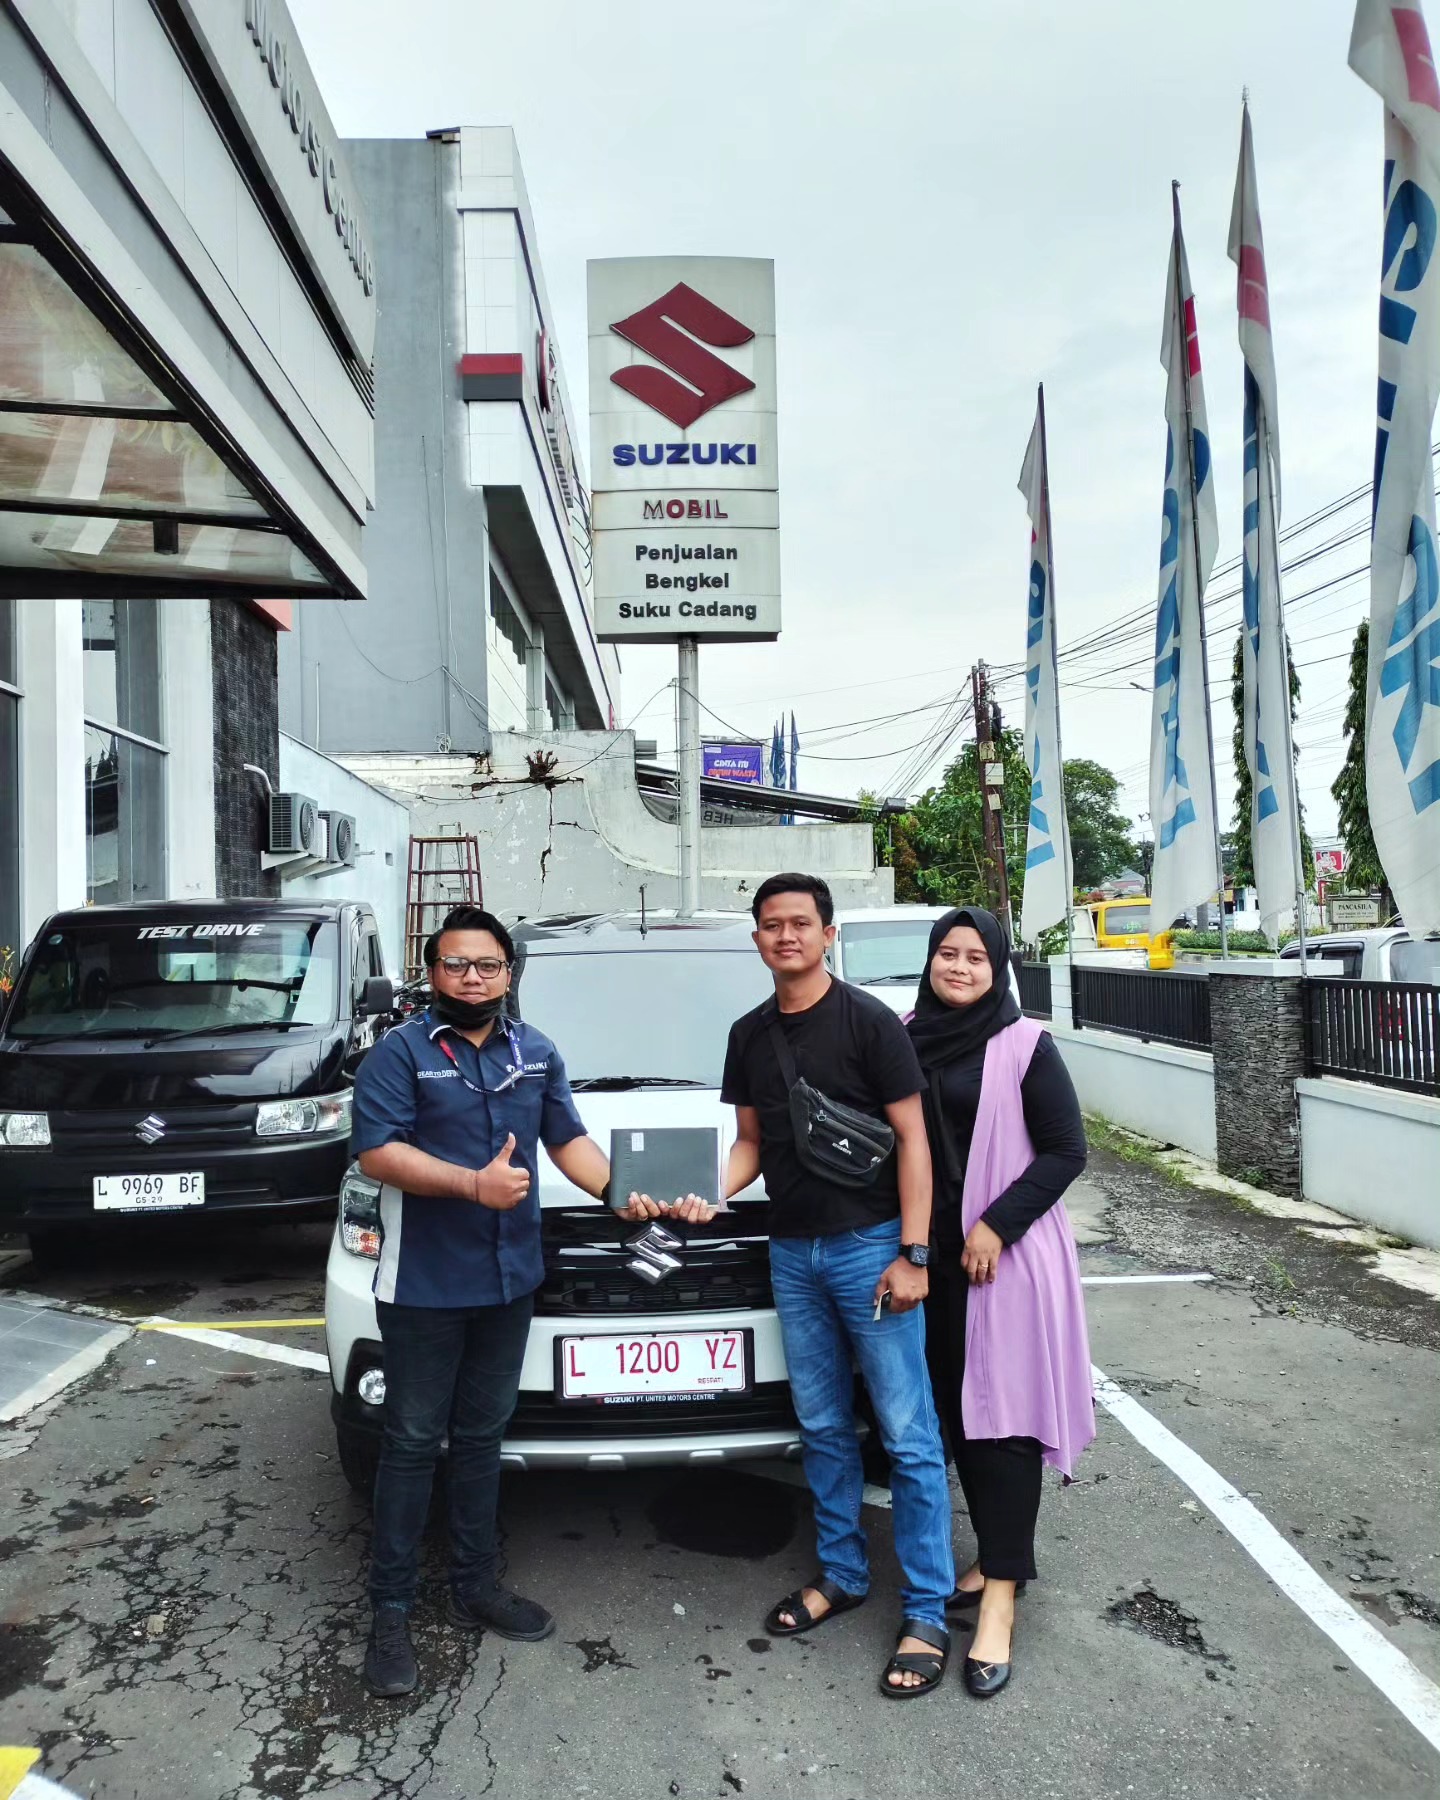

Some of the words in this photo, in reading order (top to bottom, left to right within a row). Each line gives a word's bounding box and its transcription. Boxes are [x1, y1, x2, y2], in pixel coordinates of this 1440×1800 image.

[613, 442, 757, 466] SUZUKI
[643, 499, 728, 519] MOBIL
[635, 544, 738, 562] Penjualan
[645, 573, 730, 591] Bengkel
[619, 602, 671, 619] Suku
[678, 601, 757, 621] Cadang
[714, 760, 736, 768] CINTA
[137, 925, 193, 939] TEST
[192, 924, 265, 938] DRIVE
[523, 1062, 548, 1070] ZUKI
[98, 1179, 107, 1196] L
[122, 1177, 163, 1195] 9969
[179, 1176, 199, 1193] BF
[570, 1346, 585, 1377] L
[616, 1341, 680, 1374] 1200
[705, 1338, 737, 1370] YZ
